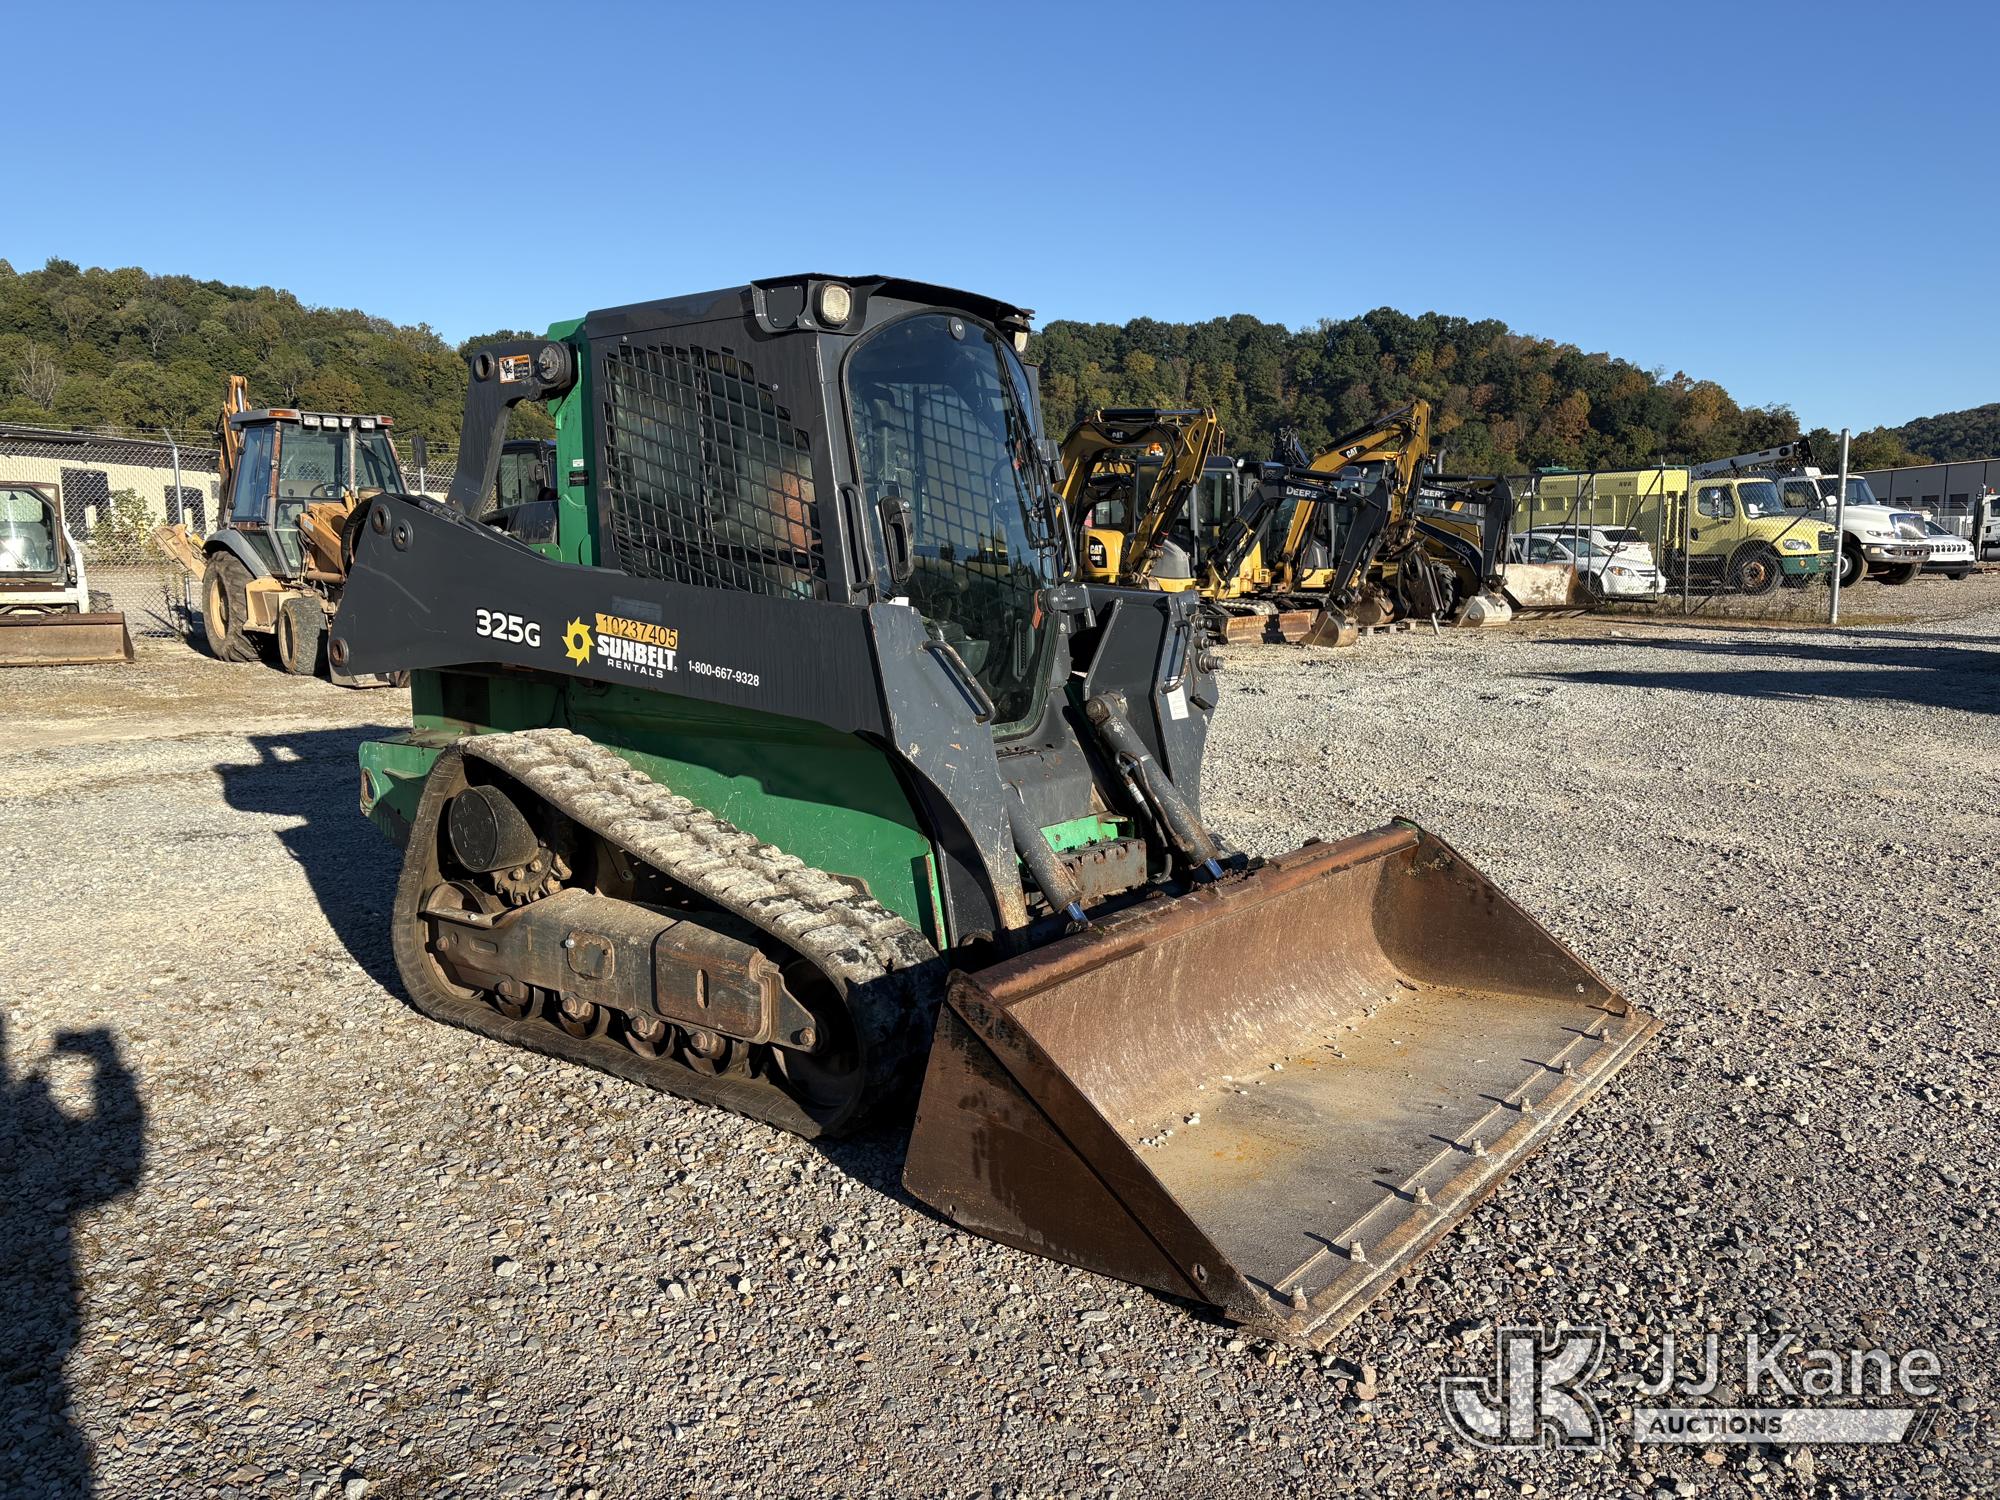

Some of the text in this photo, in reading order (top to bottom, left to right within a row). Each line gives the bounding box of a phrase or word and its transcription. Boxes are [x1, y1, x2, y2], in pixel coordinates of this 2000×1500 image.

[1346, 446, 1358, 458] CAT
[1090, 544, 1103, 555] CAT
[476, 608, 541, 648] 325G
[603, 616, 677, 648] 10237405
[597, 634, 676, 672] SUNBELT
[607, 658, 664, 679] RENTALS
[688, 660, 760, 687] 1-800-667-9328
